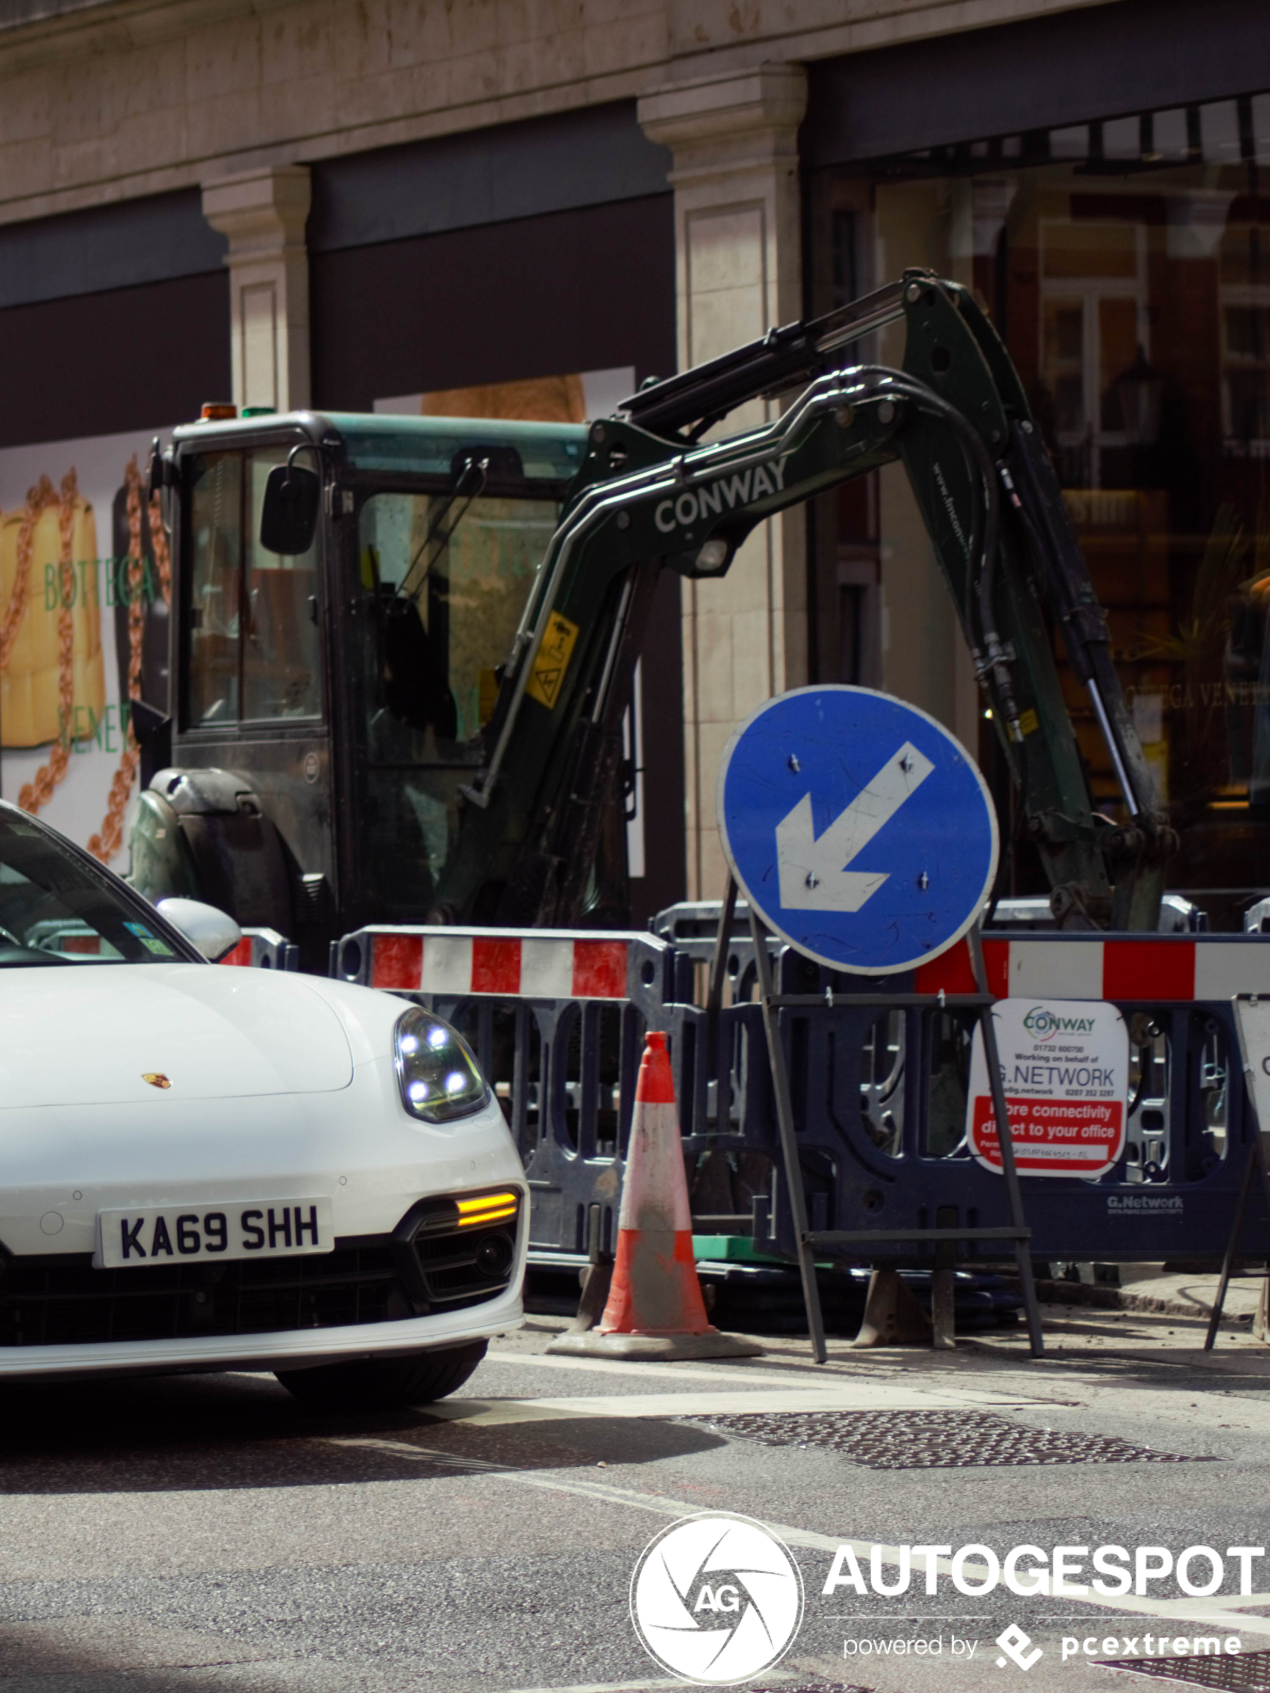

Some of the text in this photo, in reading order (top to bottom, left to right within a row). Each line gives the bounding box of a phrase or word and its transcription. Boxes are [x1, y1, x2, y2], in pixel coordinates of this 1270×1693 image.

[654, 456, 787, 533] CONWAY
[44, 555, 155, 612] BOTTEGA
[1124, 682, 1195, 710] OTTEGA
[58, 702, 132, 754] VENET
[1023, 1014, 1096, 1032] CONWAY
[1014, 1053, 1050, 1063] Working
[1064, 1055, 1089, 1063] behalf
[1033, 1044, 1057, 1052] 01732
[1032, 1104, 1111, 1122] connectivity
[981, 1120, 1115, 1140] dict to your office
[1107, 1195, 1184, 1208] G.Network
[120, 1205, 319, 1259] KA69 SHH
